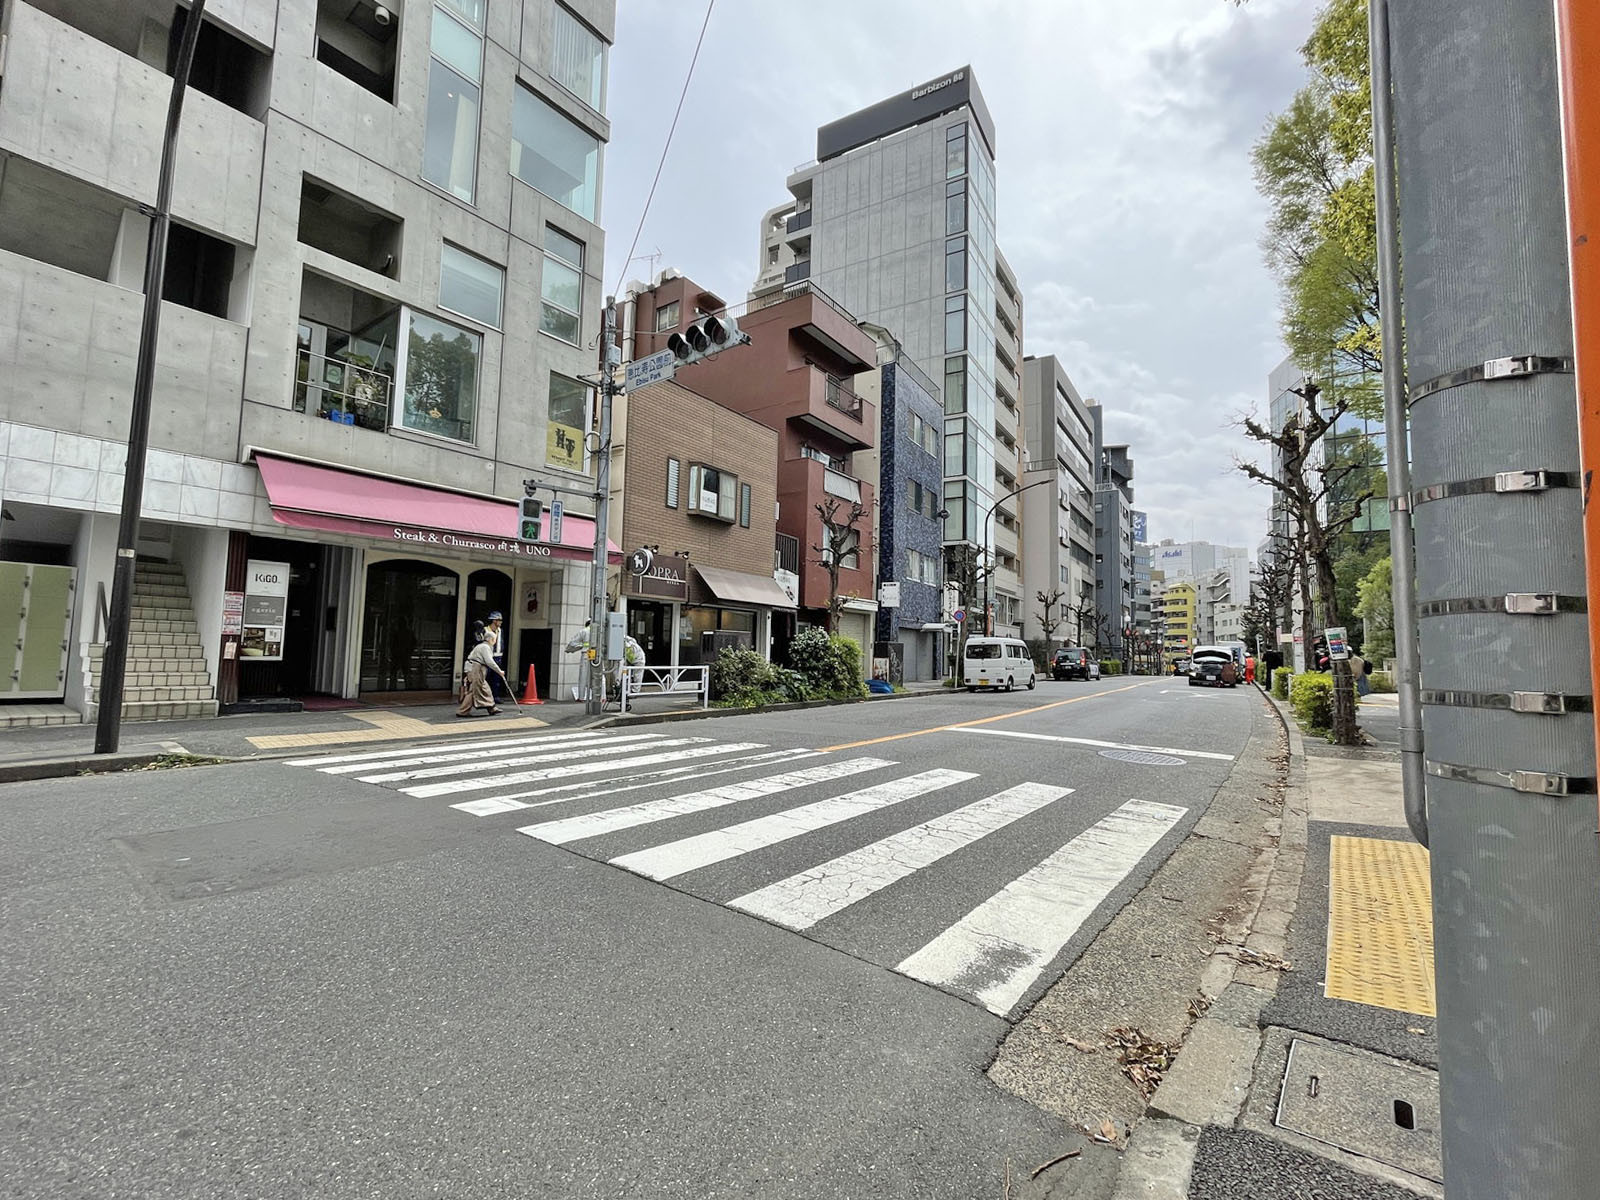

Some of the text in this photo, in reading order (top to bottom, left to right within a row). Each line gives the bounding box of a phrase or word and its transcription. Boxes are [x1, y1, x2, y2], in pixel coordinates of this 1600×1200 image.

[912, 78, 952, 100] Barbizon
[636, 372, 661, 386] Ebisu Park
[393, 527, 426, 543] Steak
[427, 533, 440, 544] &
[442, 535, 495, 551] Churrasco
[526, 546, 550, 556] UNO
